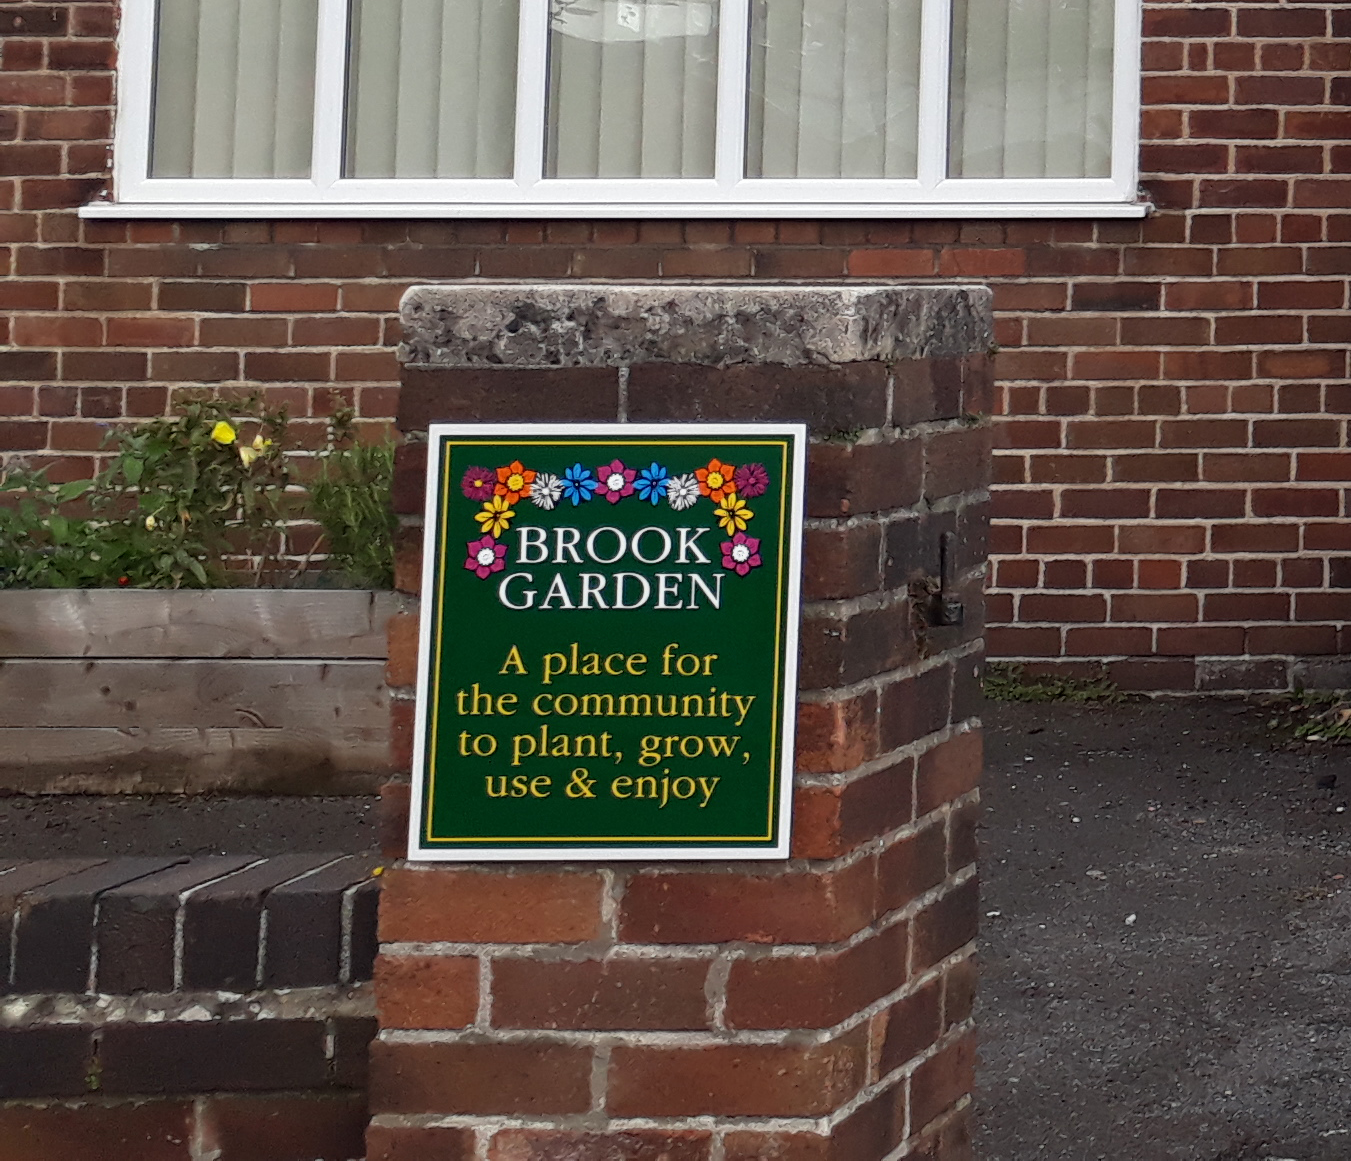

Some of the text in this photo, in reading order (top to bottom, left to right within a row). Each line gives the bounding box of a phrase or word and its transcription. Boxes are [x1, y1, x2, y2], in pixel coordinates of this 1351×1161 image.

[515, 526, 711, 564] BROOK
[498, 572, 726, 610] GARDEN
[498, 643, 718, 684] A place for
[456, 684, 757, 726] the community
[459, 724, 751, 767] to plant, grow,
[485, 767, 720, 809] use & enjoy
